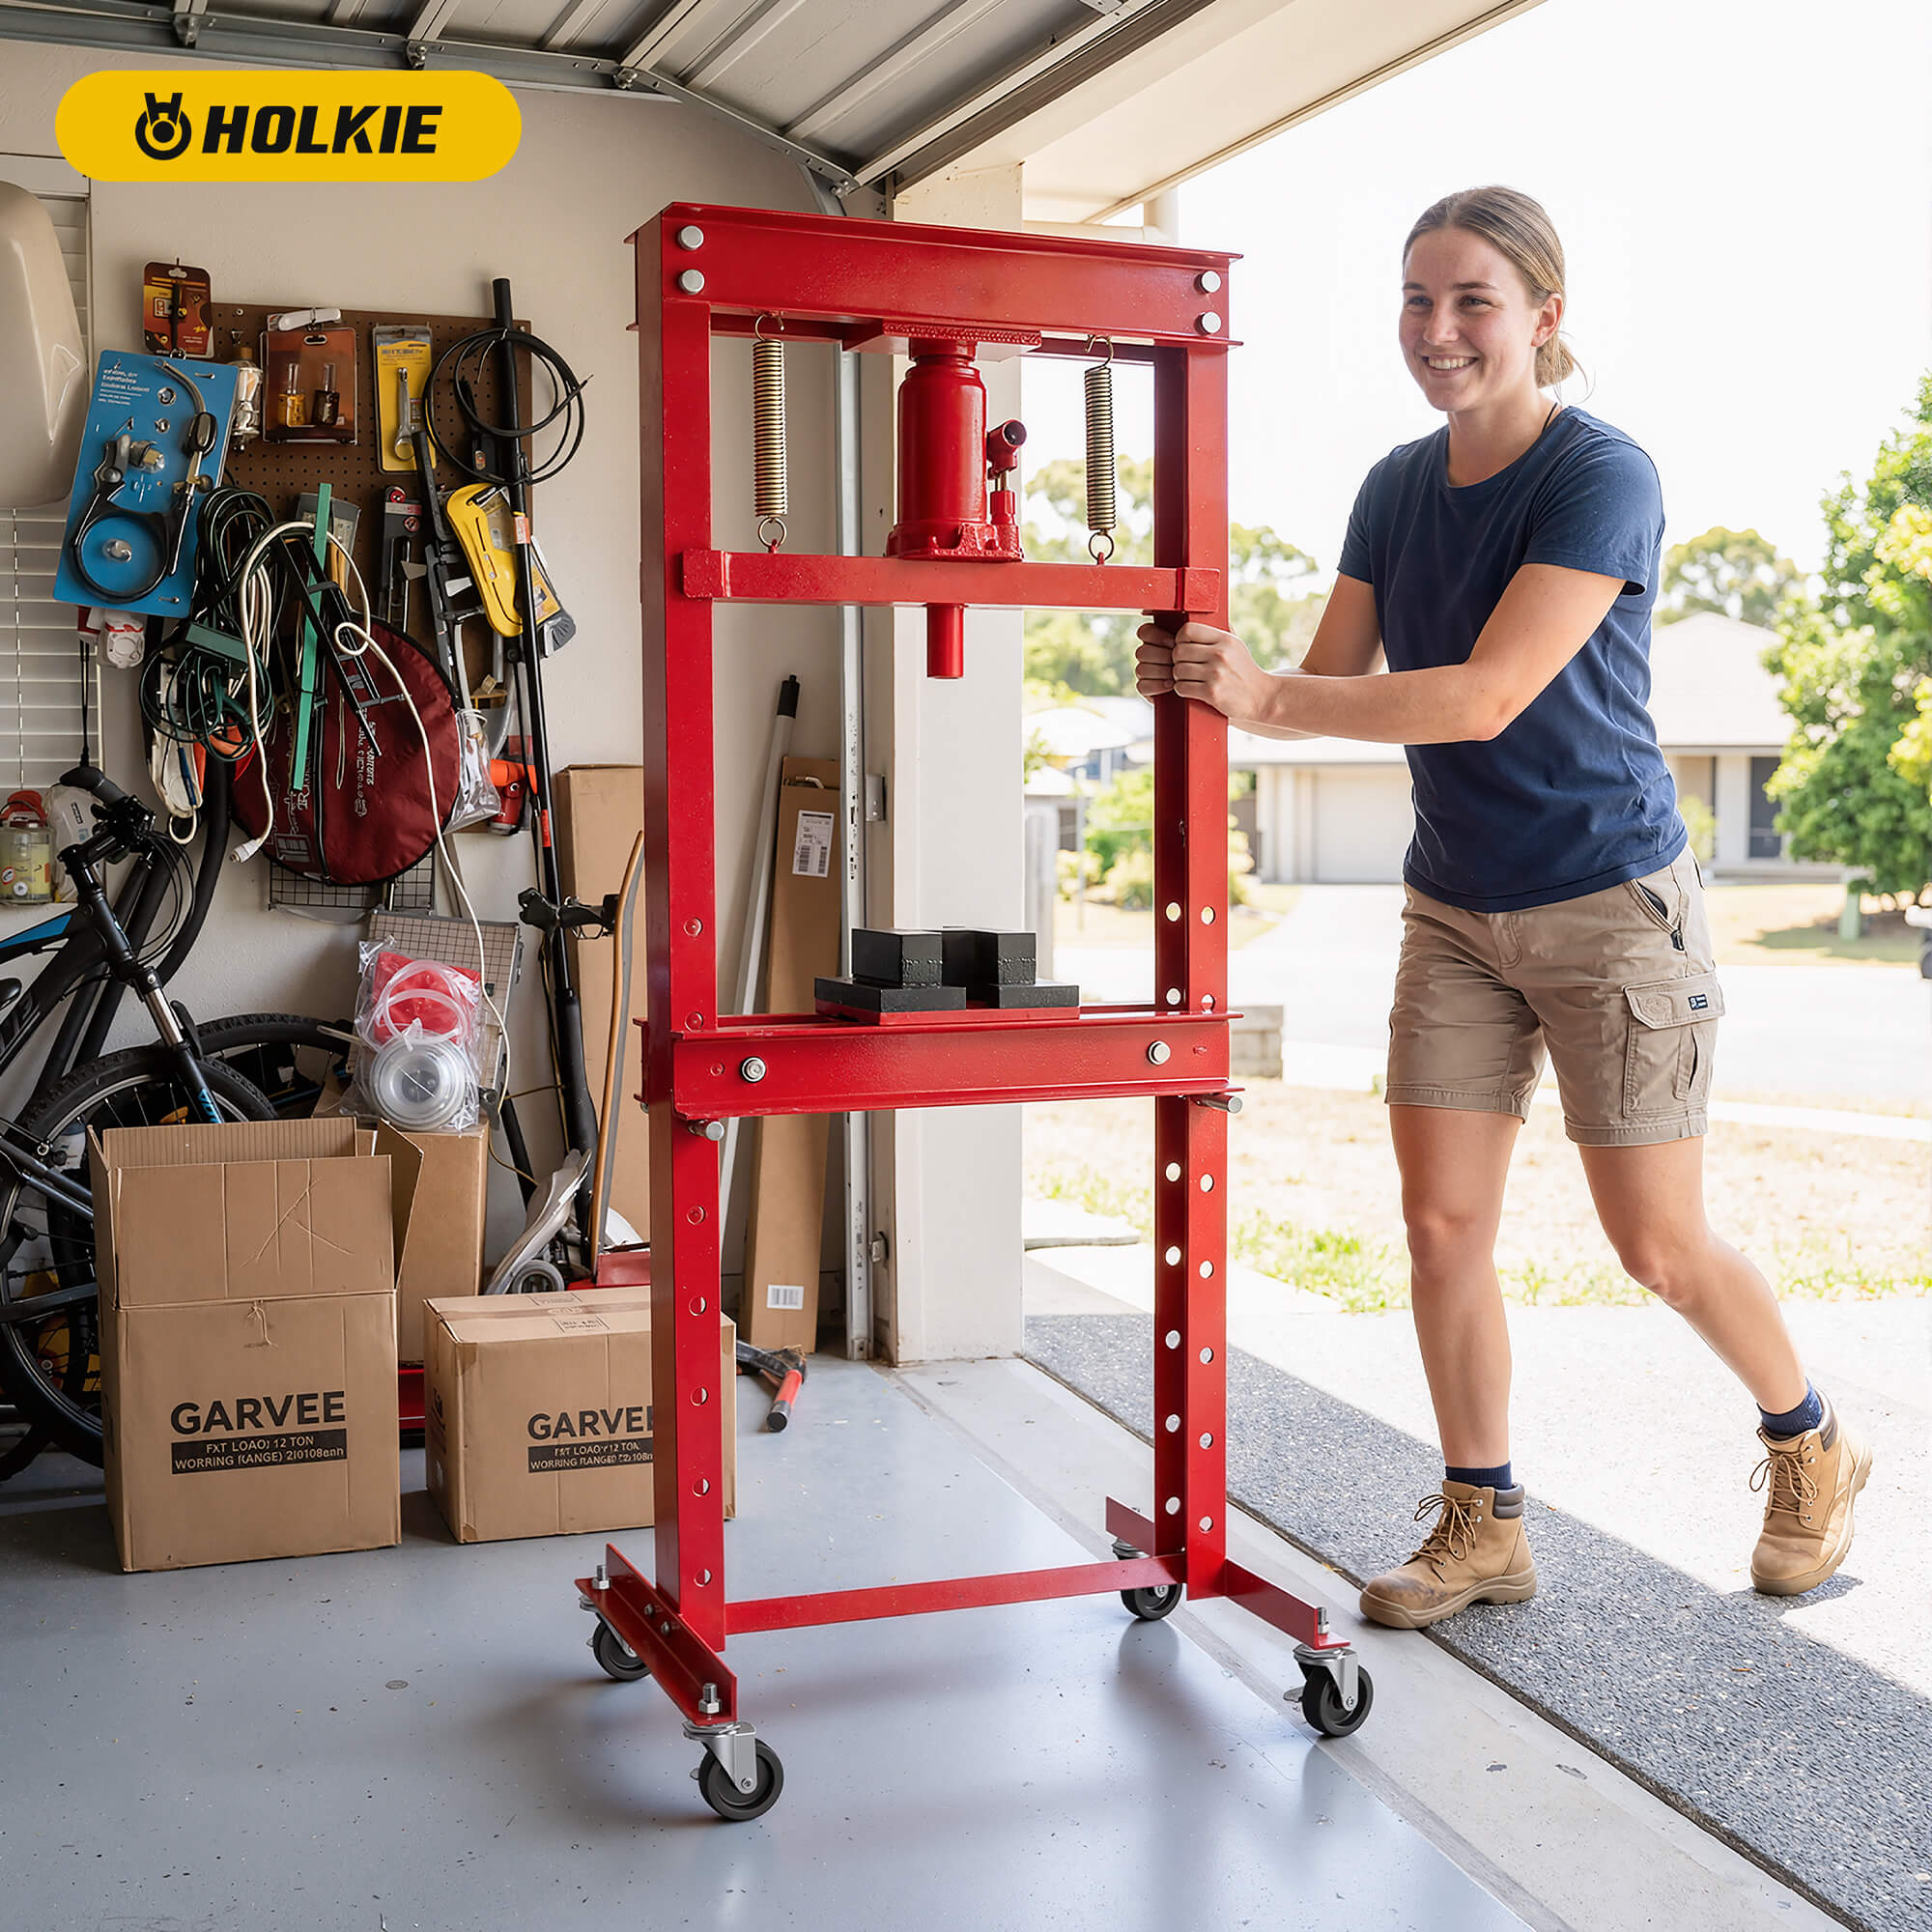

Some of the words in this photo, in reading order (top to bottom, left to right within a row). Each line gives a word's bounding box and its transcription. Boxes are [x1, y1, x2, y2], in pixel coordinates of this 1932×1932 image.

[171, 1390, 346, 1435] GARVEE
[273, 1437, 287, 1448] 12
[290, 1435, 314, 1447] TON
